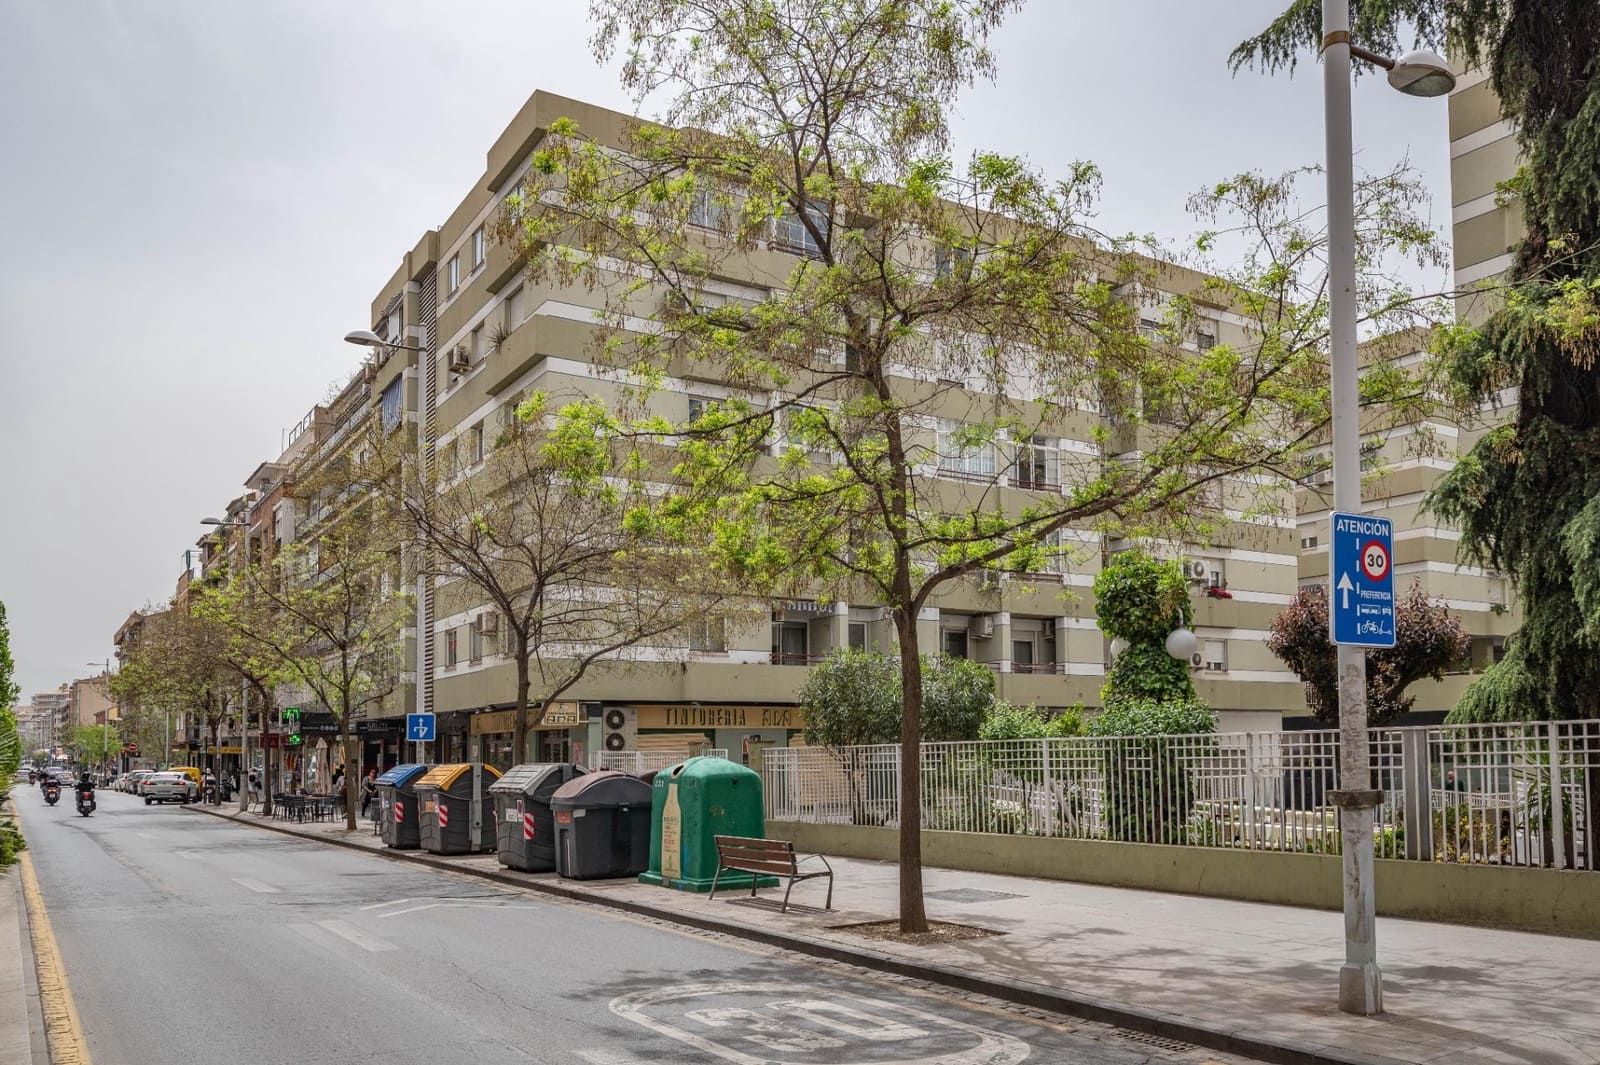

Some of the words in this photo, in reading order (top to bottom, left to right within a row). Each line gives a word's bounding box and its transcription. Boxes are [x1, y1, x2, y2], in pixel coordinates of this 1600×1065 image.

[1337, 519, 1389, 536] ATENCIÓN
[1367, 554, 1384, 568] 30
[1360, 590, 1391, 600] PREFERENCIA
[684, 999, 930, 1052] 30
